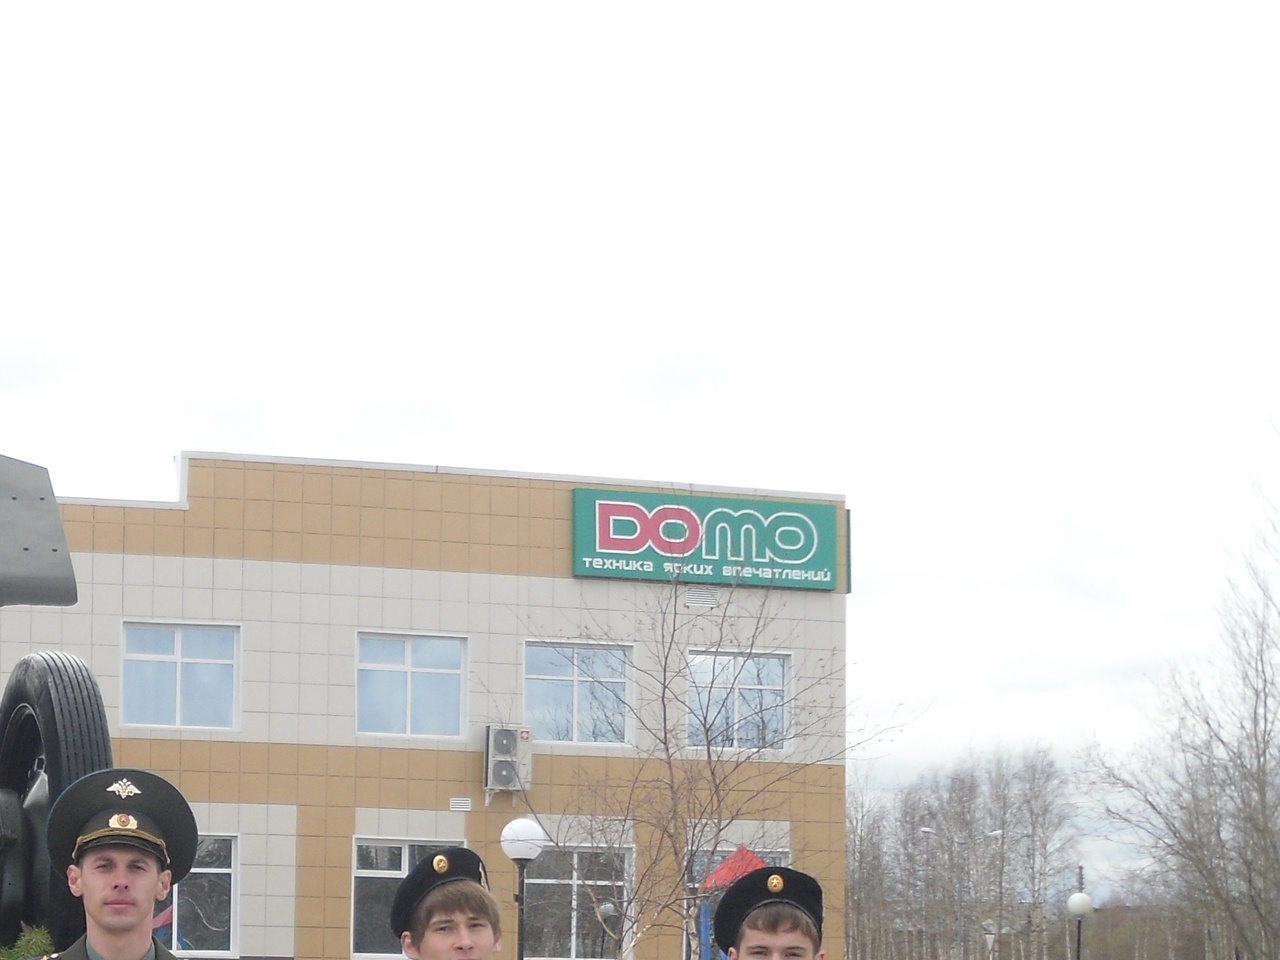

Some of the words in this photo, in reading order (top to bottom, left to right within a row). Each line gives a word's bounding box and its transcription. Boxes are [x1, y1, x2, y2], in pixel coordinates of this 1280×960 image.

[582, 557, 654, 572] техника
[663, 562, 713, 577] ярких
[722, 565, 831, 582] впечатлений
